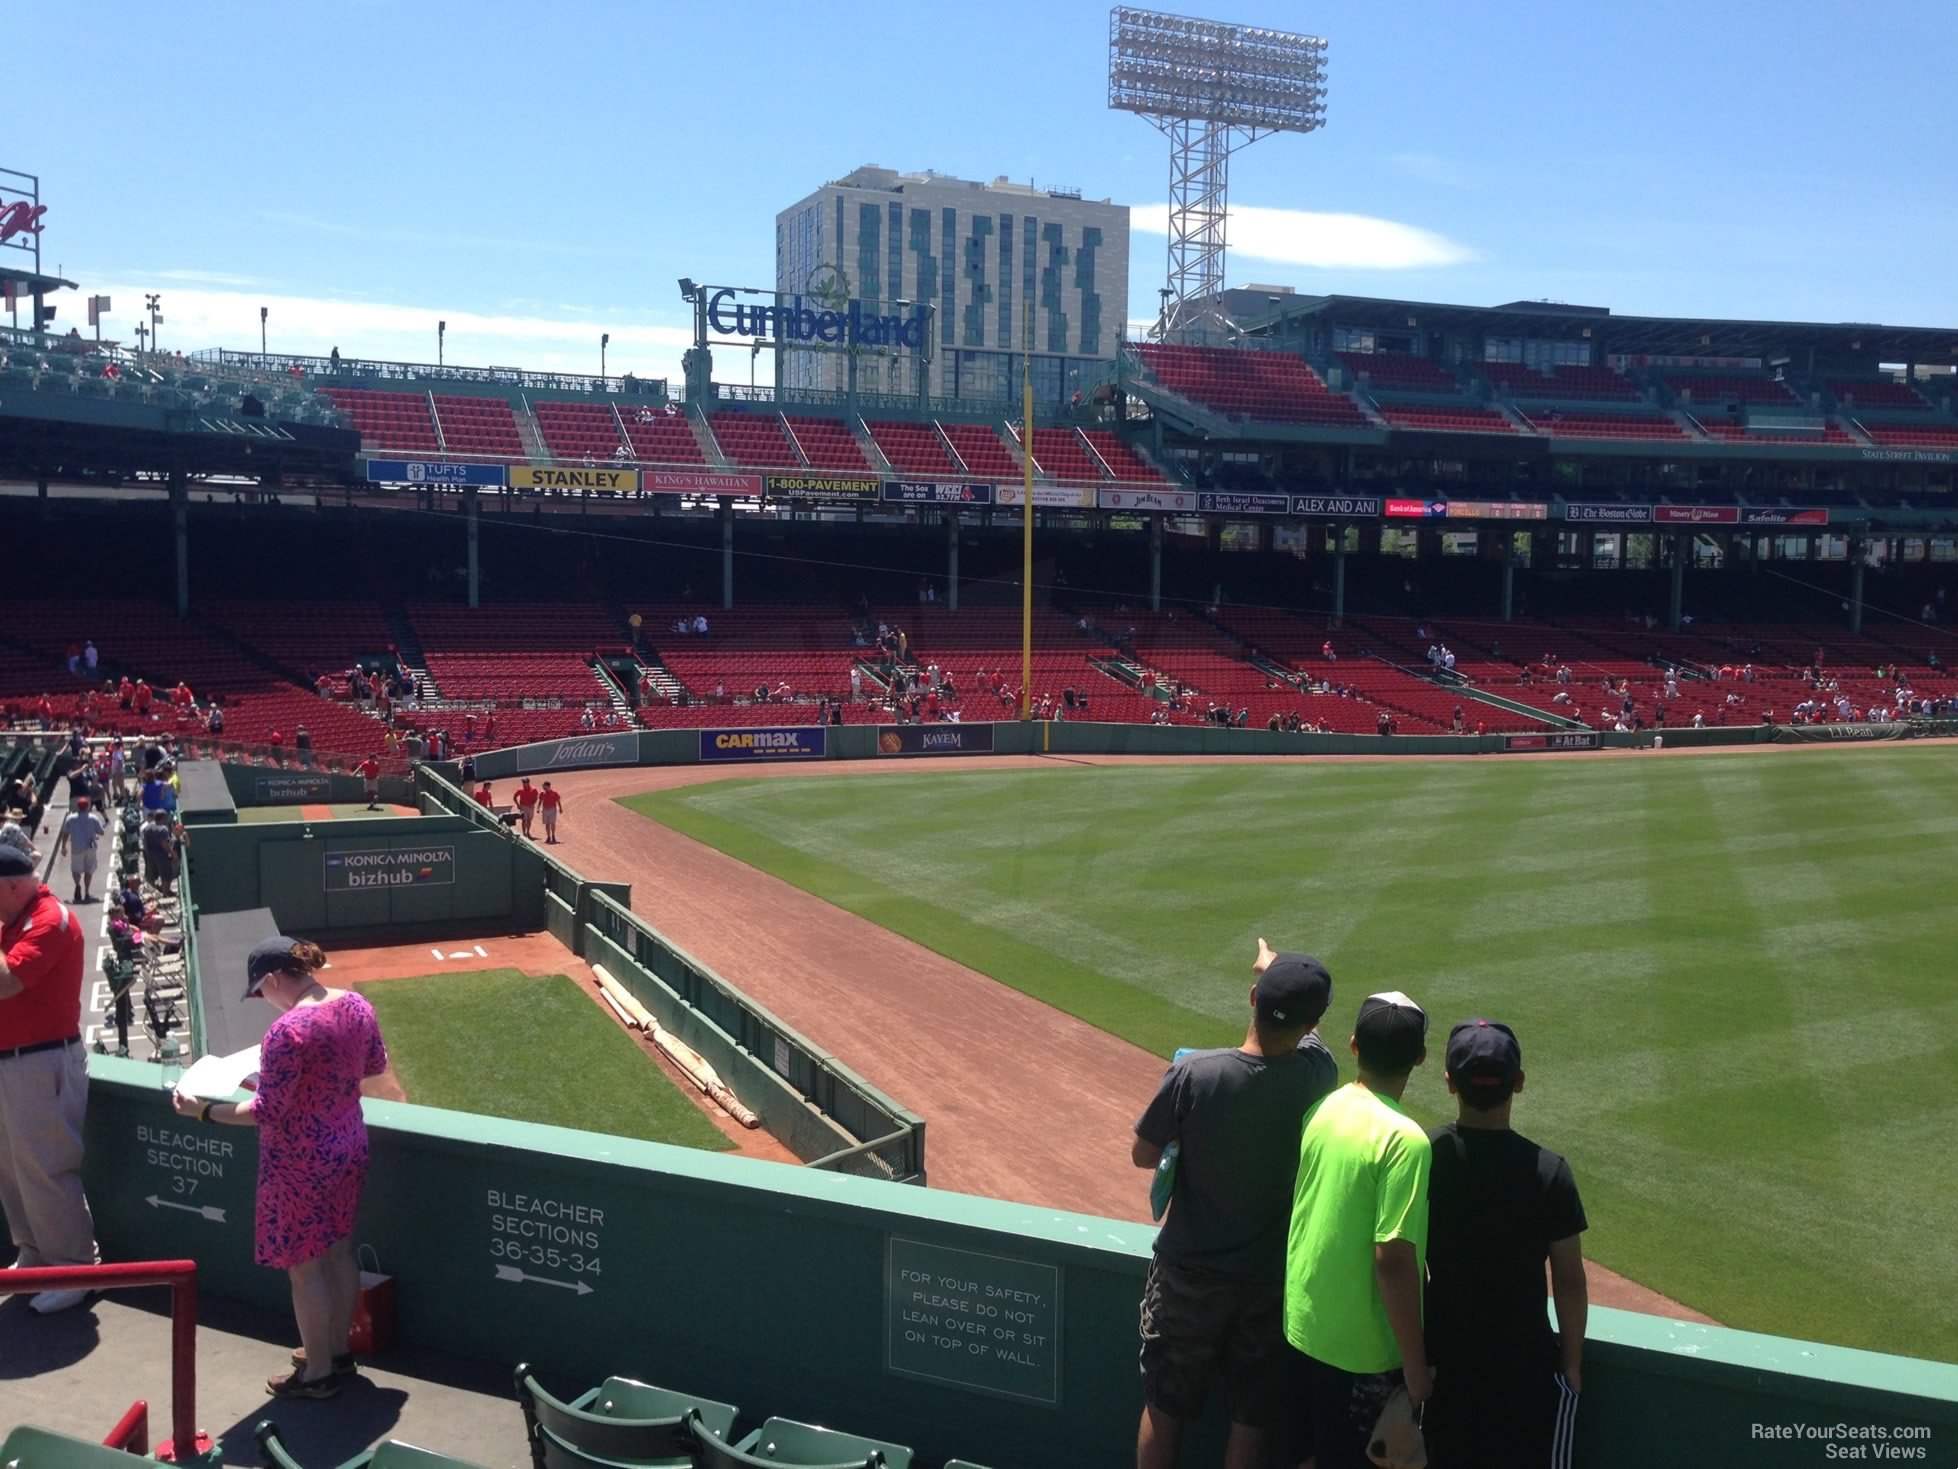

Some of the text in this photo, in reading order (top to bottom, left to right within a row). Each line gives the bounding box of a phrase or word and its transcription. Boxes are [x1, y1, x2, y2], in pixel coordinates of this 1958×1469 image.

[708, 289, 926, 348] Cumberland
[1862, 450, 1950, 461] STATE STREET PAVILION
[426, 464, 467, 475] TUFTS
[532, 470, 620, 487] STANLEY
[655, 475, 749, 487] KING'S HAWAIIAN
[768, 479, 878, 491] 1-800-PAVEMENT
[788, 489, 859, 498] USPavement.com
[900, 484, 914, 492] The
[935, 484, 962, 495] WEEI
[1216, 495, 1285, 505] Beth Israel Deaconess
[1297, 499, 1375, 513] ALEX AND ANI
[1216, 503, 1264, 512] Medical Center
[1583, 508, 1648, 519] The Boston Globe
[1669, 510, 1690, 520] Ninety
[1702, 511, 1719, 519] Nine
[1748, 513, 1786, 523] Safelite
[922, 733, 962, 748] KAYEM
[1562, 735, 1590, 746] At Bat
[546, 741, 616, 766] Jordan's
[267, 777, 329, 786] KONICA MINOLTA
[270, 787, 308, 797] bizhub
[344, 851, 452, 867] KONICA MINOLTA
[349, 869, 413, 886] bizhub
[137, 1125, 233, 1158] BLEACHER
[147, 1148, 223, 1178] SECTION
[171, 1175, 199, 1195] 37
[487, 1189, 604, 1227] BLEACHER
[492, 1214, 599, 1249] SECTIONS
[489, 1238, 602, 1276] 36-35-34
[901, 1269, 1046, 1308] FOR YOUR SAFETY,
[912, 1291, 1035, 1325] PLEASE DO NOT
[902, 1309, 1046, 1348] LEAN OVER OR SIT
[905, 1329, 1040, 1367] ON TOP OF WALL.
